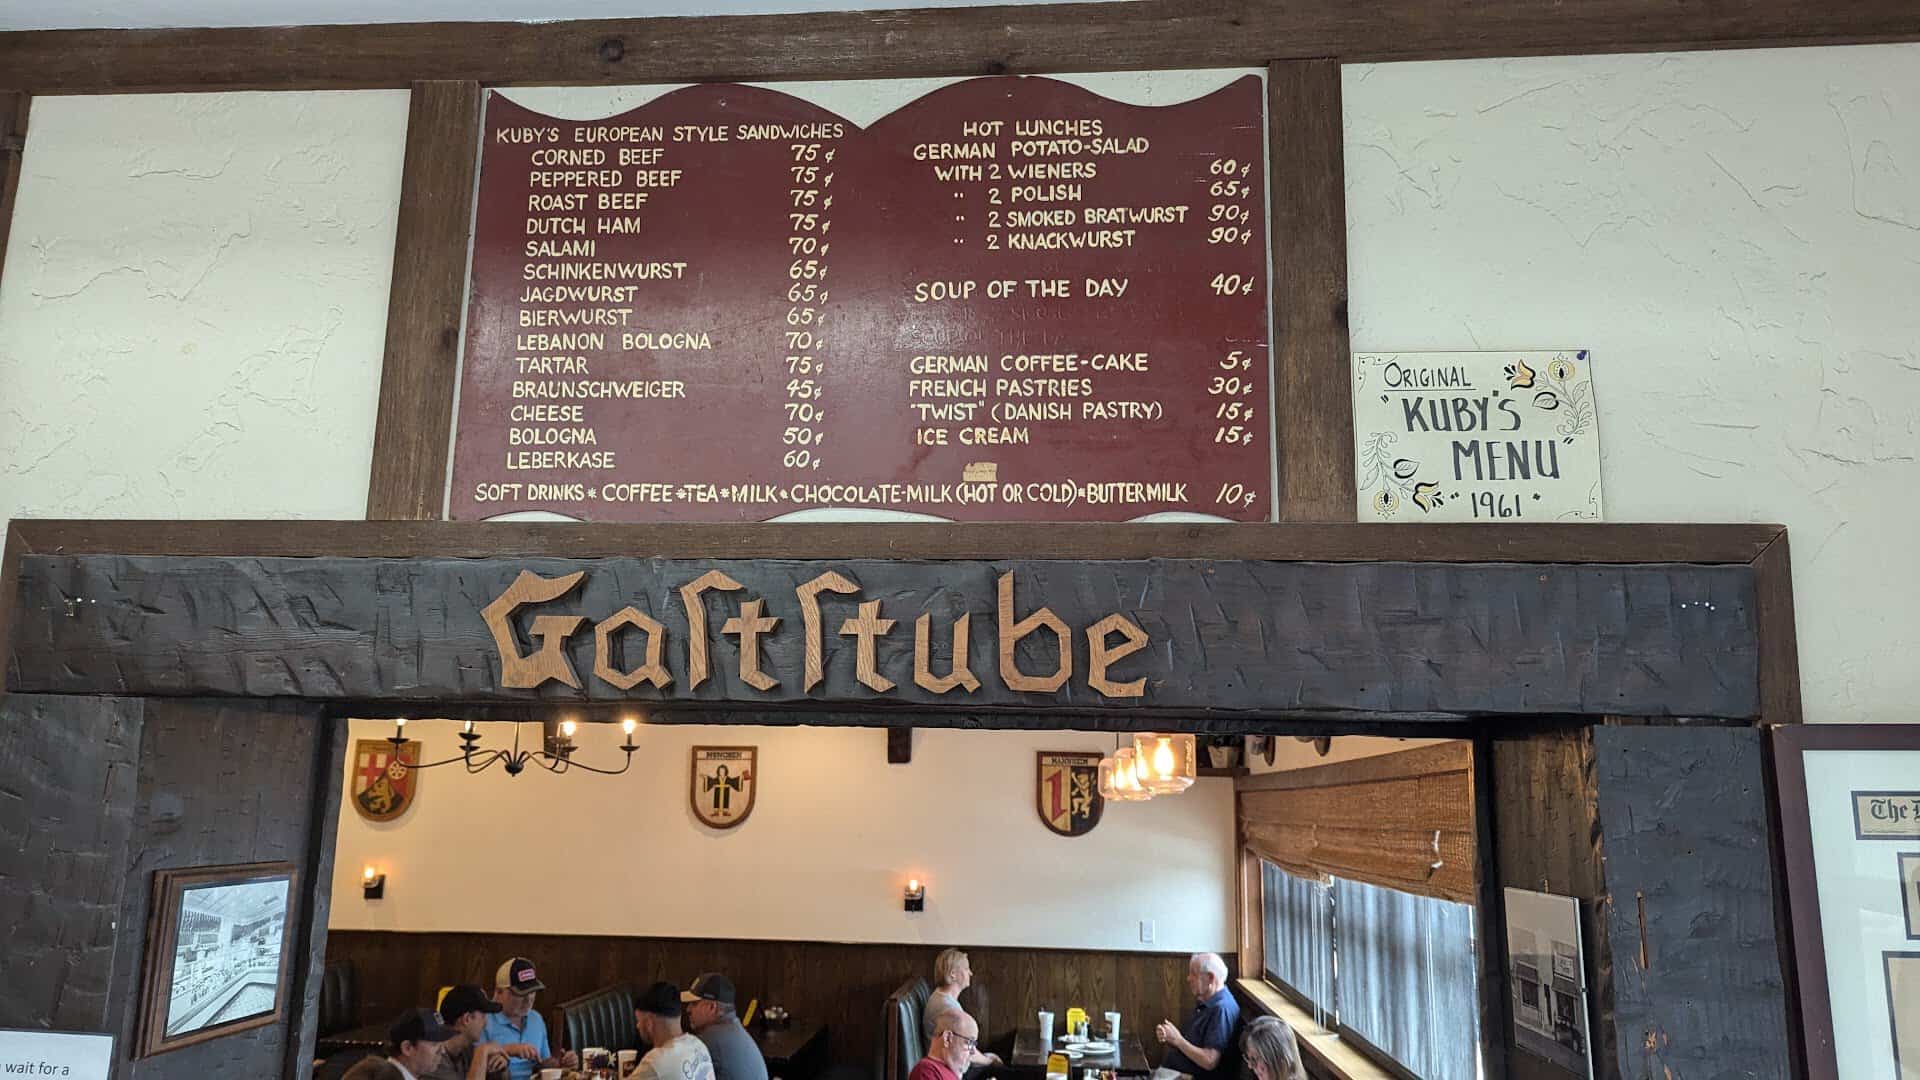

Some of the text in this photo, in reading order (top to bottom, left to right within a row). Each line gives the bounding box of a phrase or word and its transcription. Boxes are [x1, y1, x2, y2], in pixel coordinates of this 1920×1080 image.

[497, 123, 843, 143] KUBY'S EUROPEAN STYLE SANDWICHES
[964, 120, 1102, 136] HOT LUNCHES
[532, 149, 605, 166] CORNED
[619, 148, 664, 166] BEEF
[914, 143, 995, 160] GERMAN
[530, 170, 622, 187] PEPPERED
[637, 170, 682, 187] BEEF
[934, 165, 982, 181] WITH
[988, 164, 1001, 179] 2
[1008, 162, 1096, 179] WIENERS
[529, 194, 588, 211] ROAST
[599, 193, 648, 209] BEEF
[989, 188, 1002, 204] 2
[1012, 184, 1081, 202] POLISH
[989, 211, 1001, 227] 2
[1006, 210, 1076, 227] SMOKED
[1084, 206, 1189, 224] BRATWURST
[527, 218, 585, 234] DUTCH
[598, 217, 640, 234] HAM
[525, 240, 595, 257] SALAMI
[987, 235, 1000, 249] 2
[1009, 230, 1135, 250] KNACKWURST
[523, 263, 687, 280] SCHINKENWURST
[520, 286, 638, 302] JAGDWURST
[915, 281, 976, 302] SOUP
[987, 280, 1017, 298] OF
[1025, 280, 1070, 297] THE
[1086, 279, 1128, 297] DAY
[520, 309, 632, 326] BIERWURST
[518, 333, 603, 350] LEBANON
[623, 333, 711, 349] BOLOGNA
[516, 357, 589, 374] TARTAR
[910, 355, 988, 374] GERMAN
[513, 381, 685, 398] BRAUNSCHWEIGER
[910, 379, 986, 397] FRENCH
[997, 379, 1092, 396] PASTRIES
[511, 405, 583, 422] CHEESE
[510, 428, 596, 445] BOLOGNA
[918, 428, 948, 445] ICE
[959, 427, 1029, 445] CREAM
[507, 451, 615, 469] LEBERKASE
[475, 483, 522, 501] SOFT
[1003, 484, 1023, 503] OR
[1871, 799, 1907, 823] The
[5, 1061, 70, 1076] wait for a
